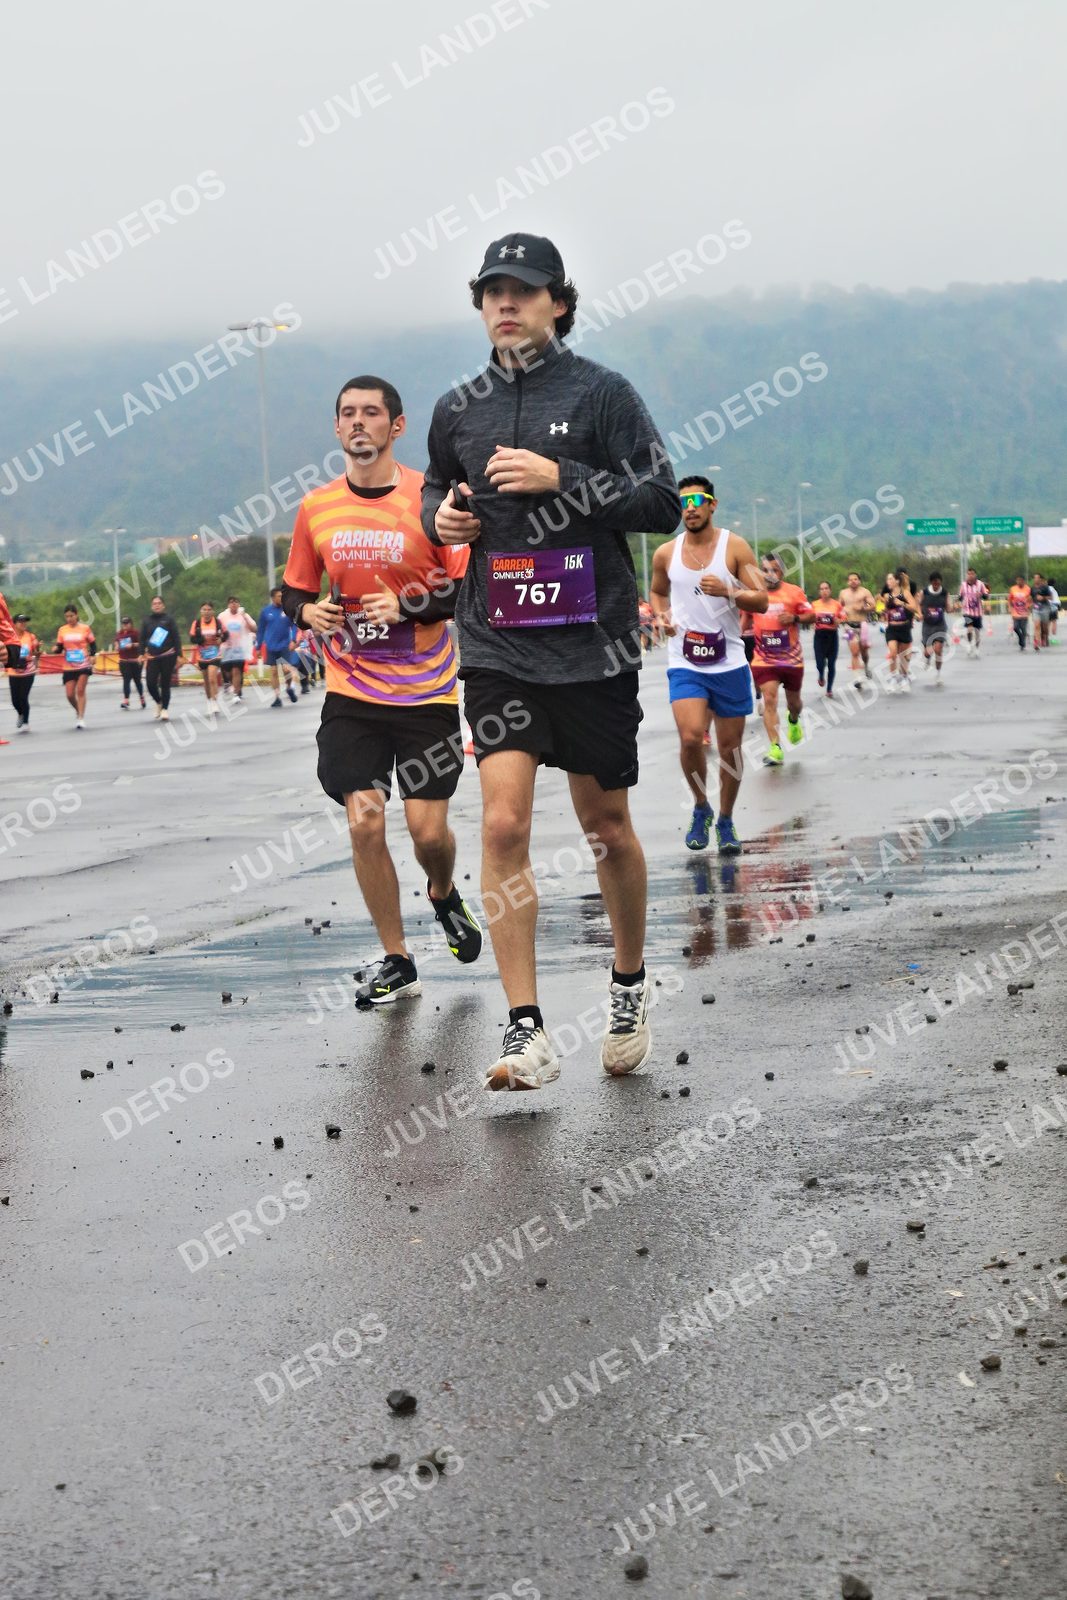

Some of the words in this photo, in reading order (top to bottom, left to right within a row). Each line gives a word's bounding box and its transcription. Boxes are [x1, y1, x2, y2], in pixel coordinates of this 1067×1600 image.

[331, 530, 404, 550] CARRERA
[332, 550, 386, 562] OMNILIFE
[492, 558, 535, 571] CARRERA
[493, 570, 524, 580] OMNILIFE
[514, 582, 561, 605] 767
[357, 623, 390, 640] 552
[692, 645, 716, 657] 804
